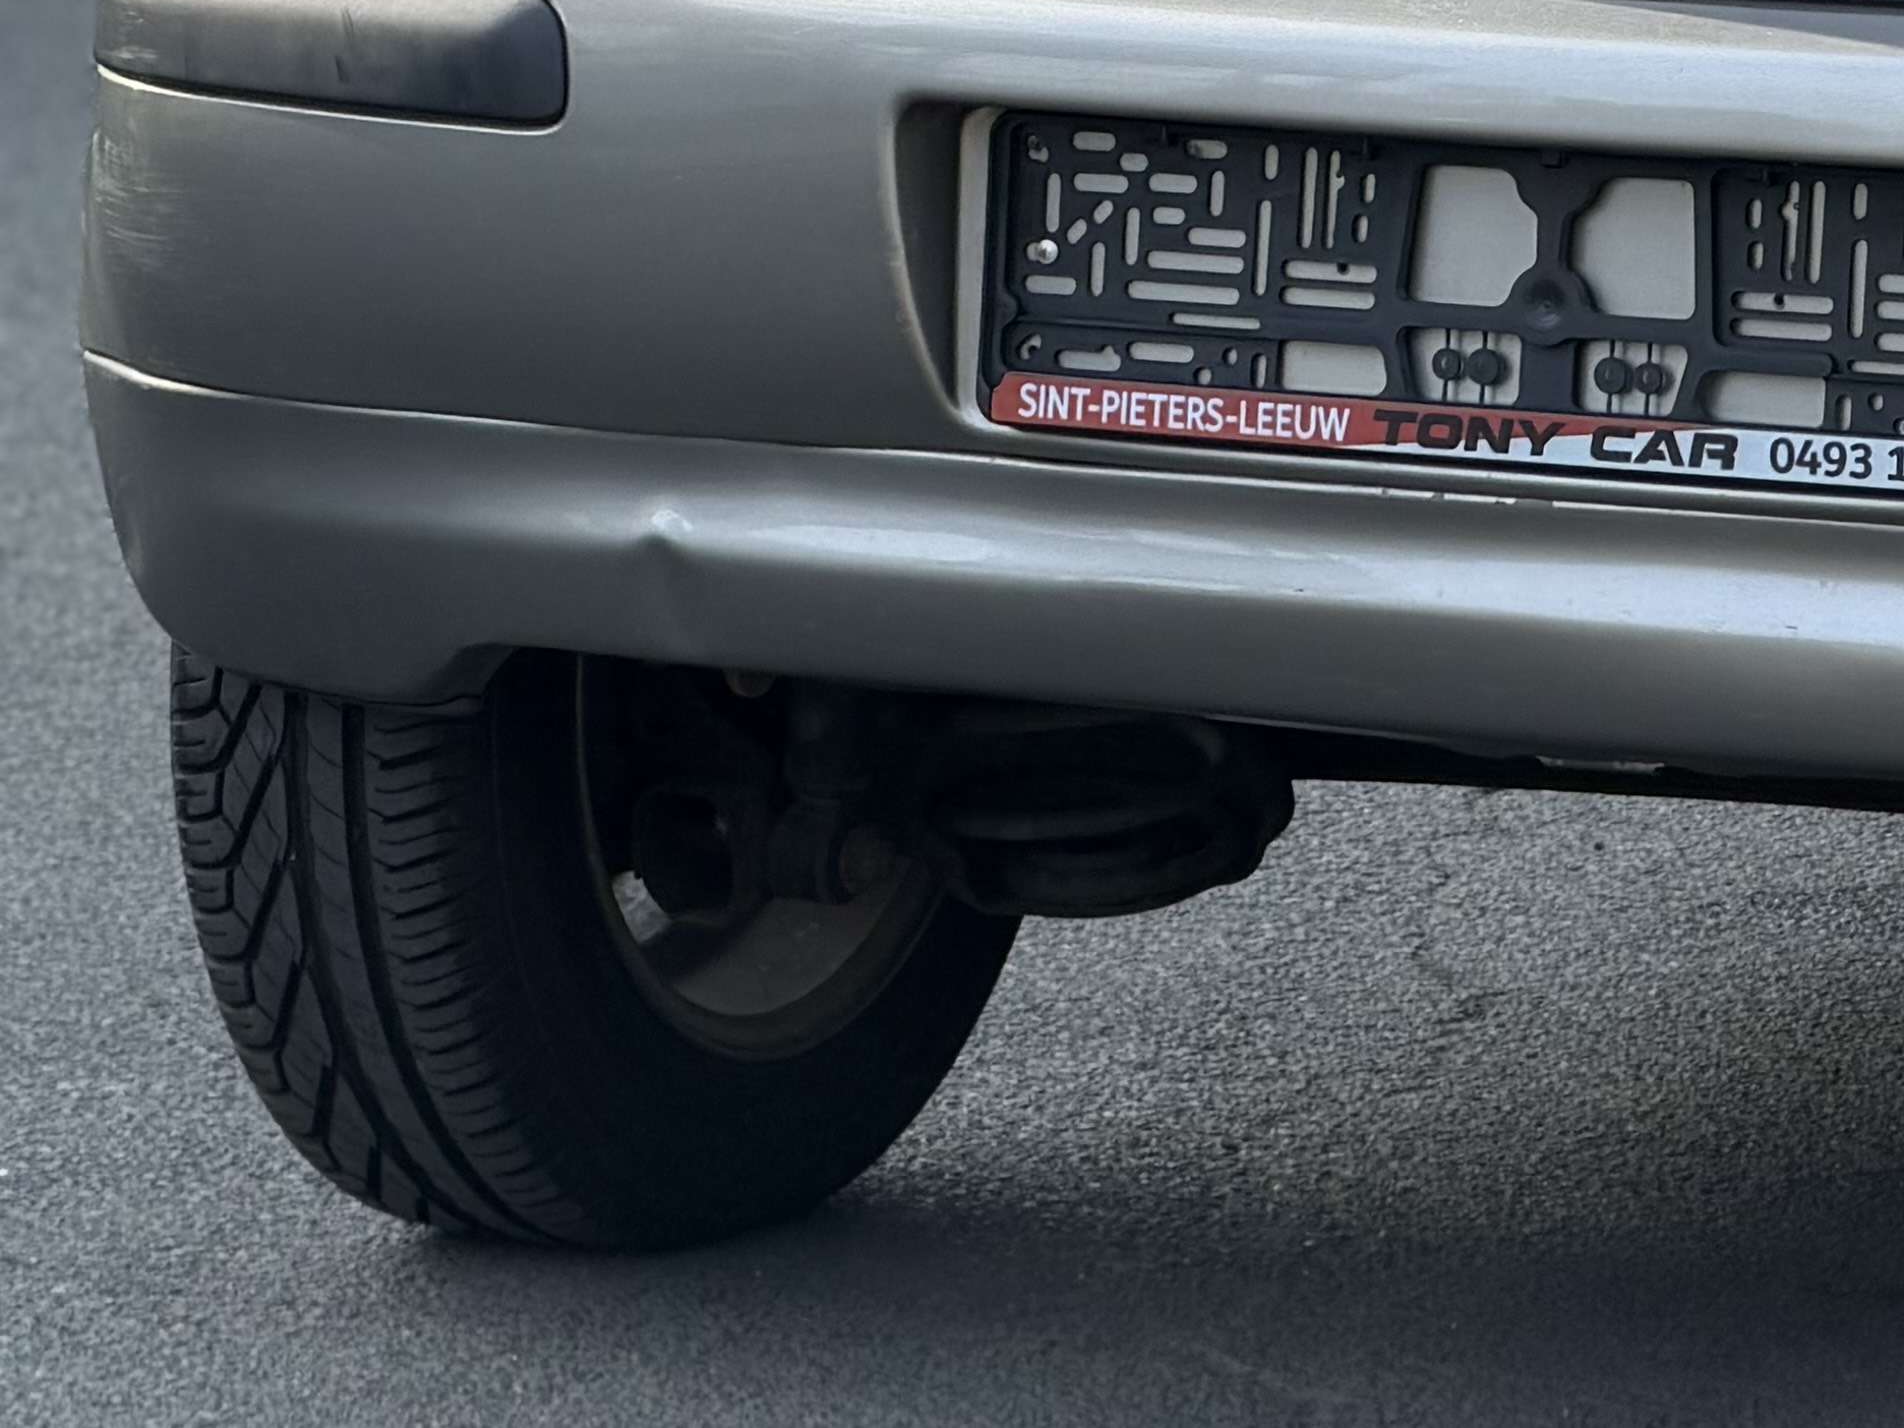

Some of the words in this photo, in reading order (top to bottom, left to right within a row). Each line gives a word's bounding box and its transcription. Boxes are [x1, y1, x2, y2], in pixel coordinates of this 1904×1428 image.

[1017, 382, 1351, 443] SINT-PIETERS-LEEUW
[1373, 408, 1566, 456] TONY
[1589, 425, 1739, 471] CAR
[1769, 436, 1873, 480] 0493
